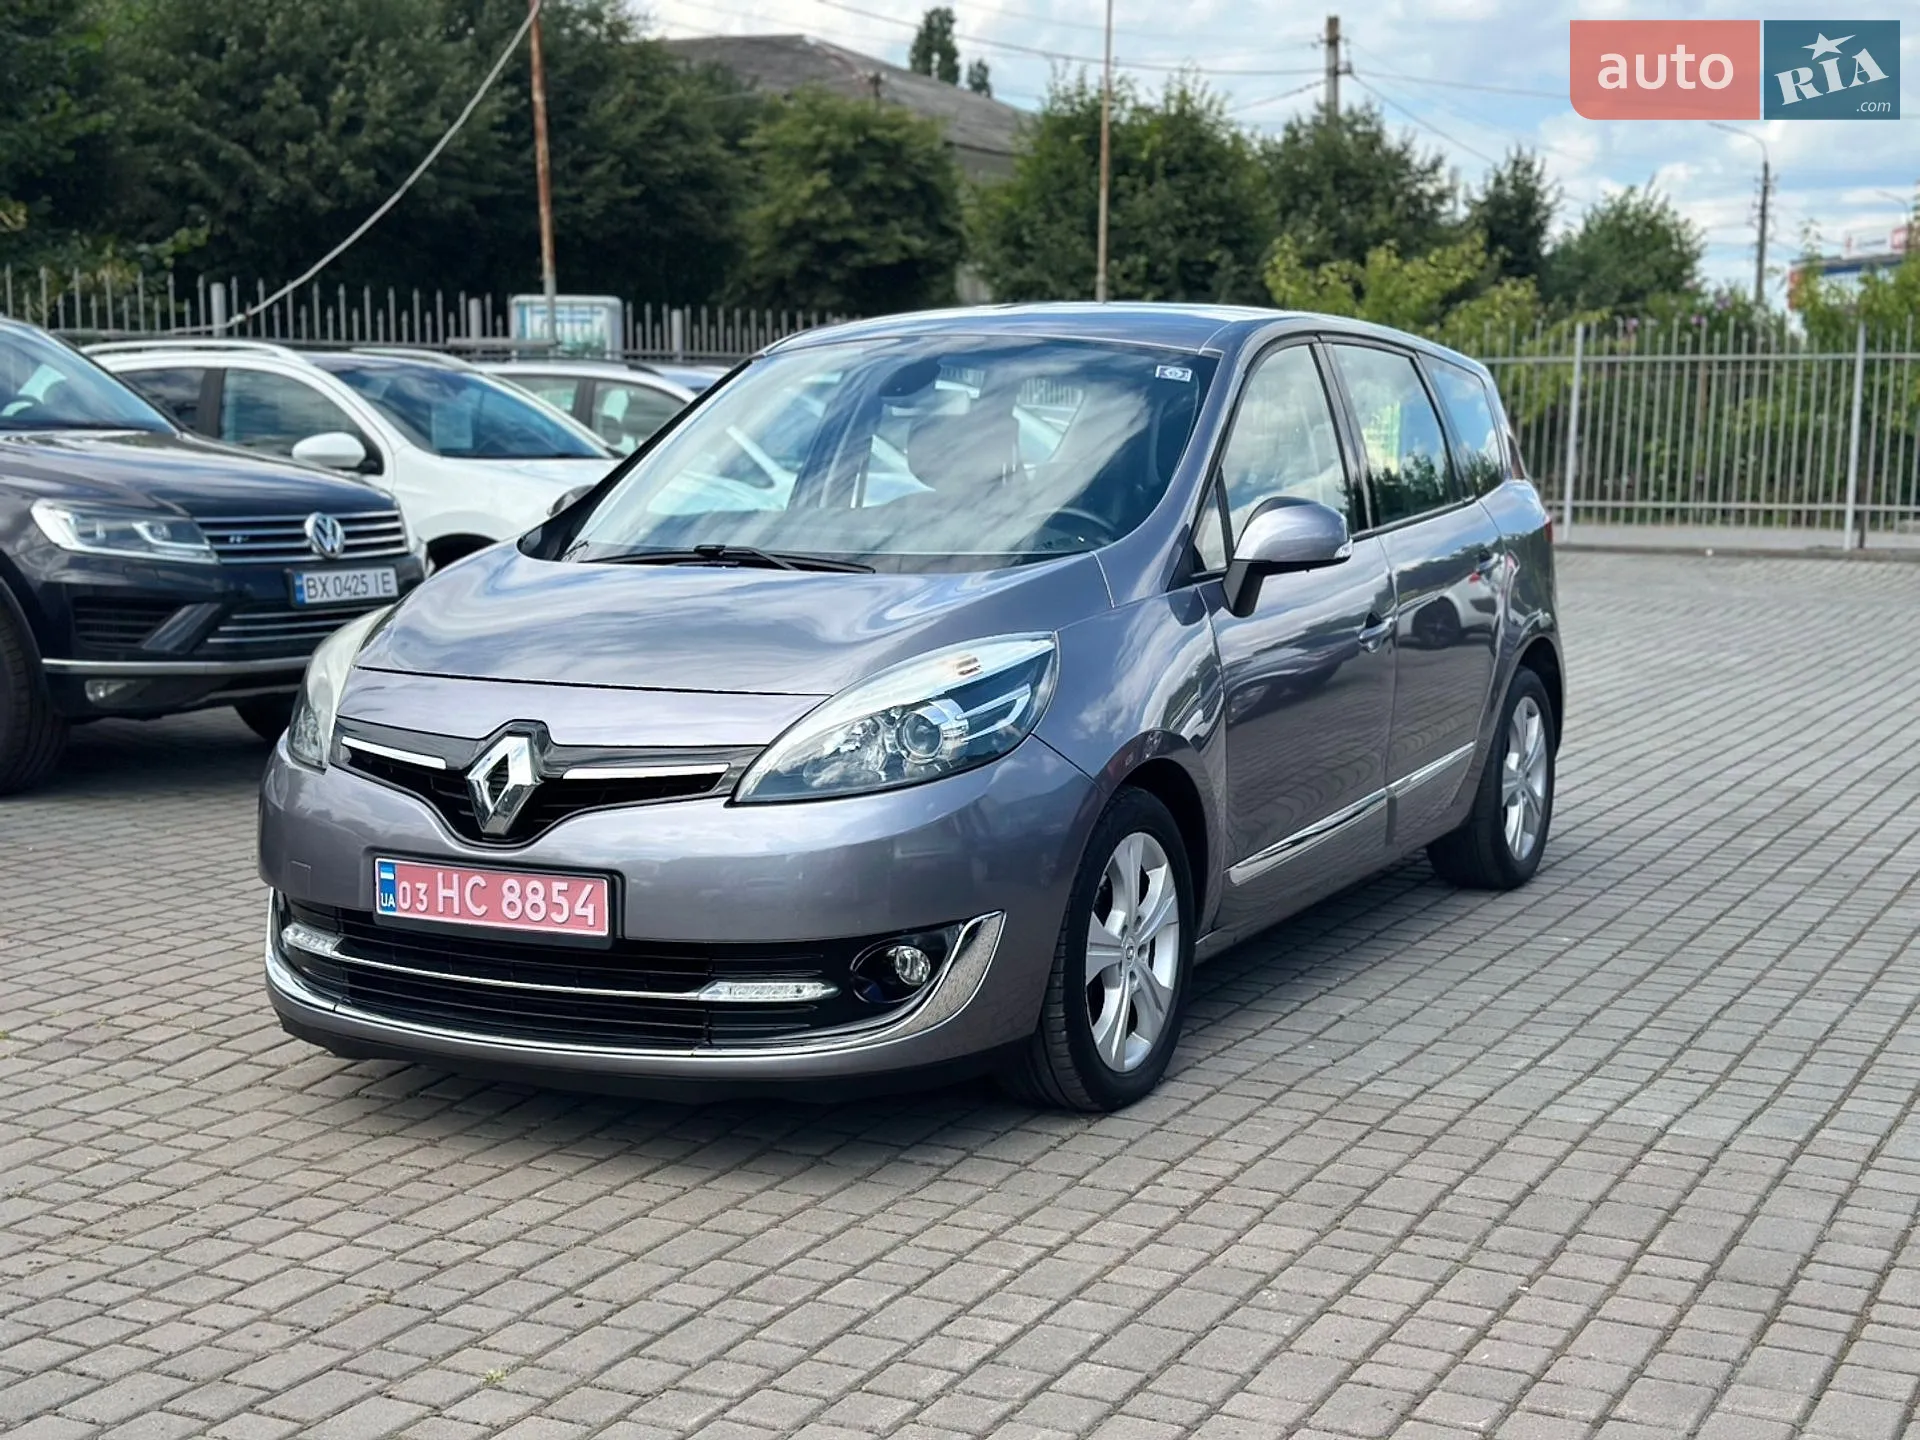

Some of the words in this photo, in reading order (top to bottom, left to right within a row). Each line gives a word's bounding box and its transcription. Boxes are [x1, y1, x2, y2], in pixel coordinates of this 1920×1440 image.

[306, 576, 330, 599] BX
[333, 574, 369, 596] 0425
[374, 572, 392, 594] IE
[380, 892, 396, 908] UA
[398, 880, 429, 912] 03
[437, 871, 488, 916] HC
[501, 878, 595, 926] 8854
